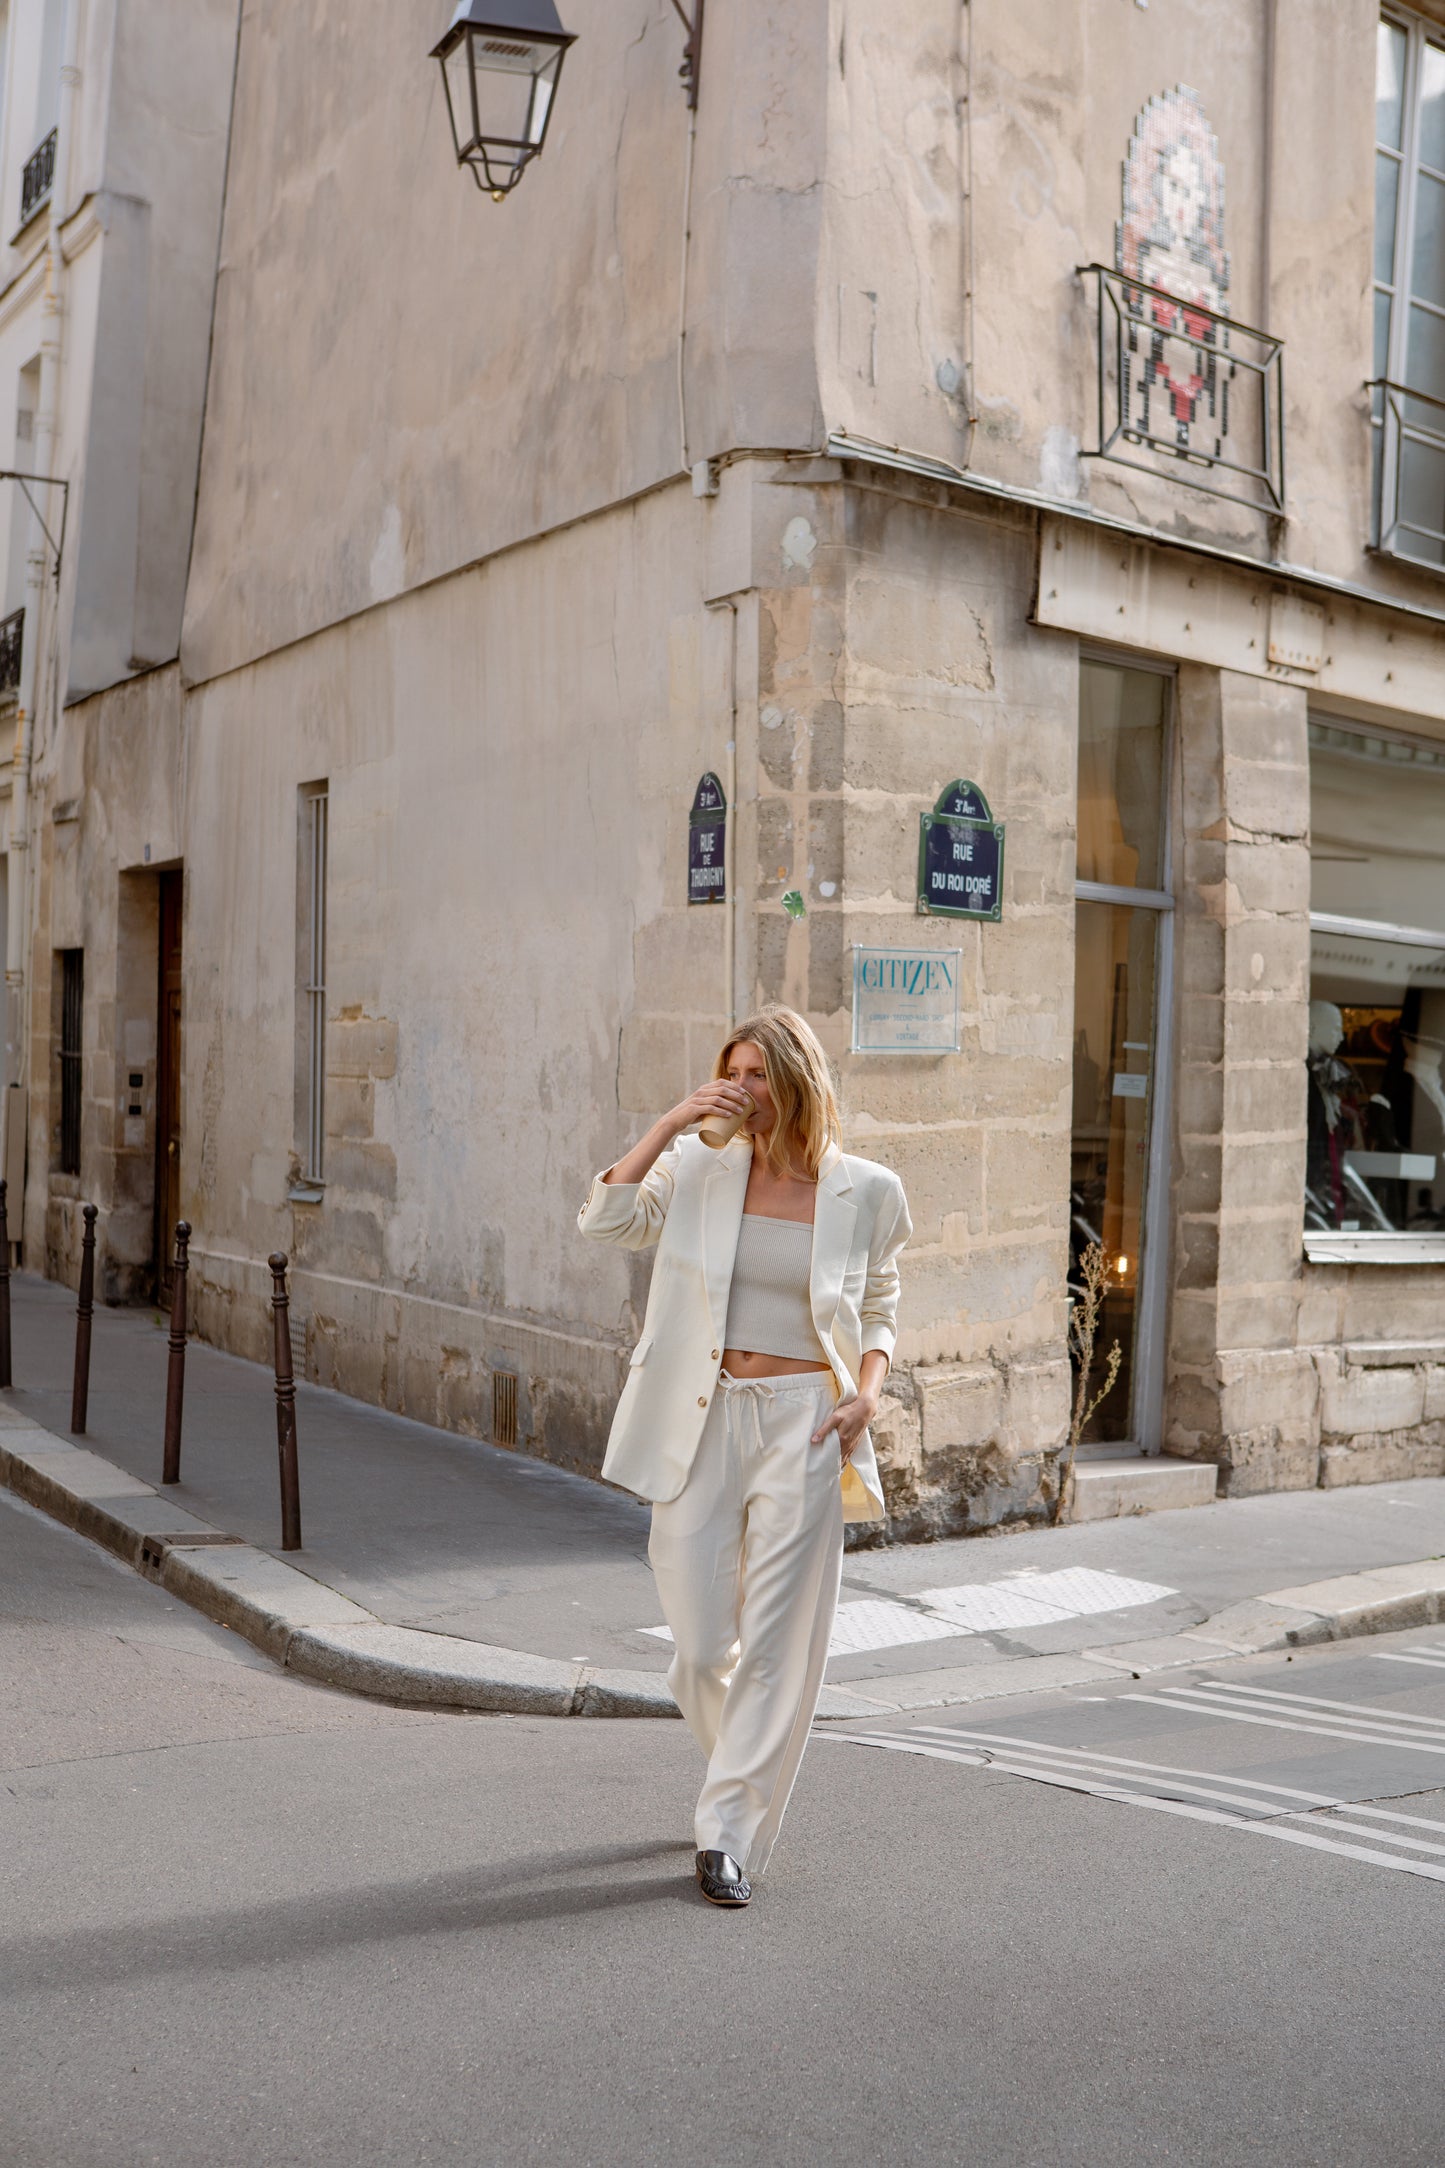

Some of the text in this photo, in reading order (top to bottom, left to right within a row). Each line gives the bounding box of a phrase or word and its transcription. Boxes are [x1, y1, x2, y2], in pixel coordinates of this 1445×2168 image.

[700, 833, 715, 852] RUE
[953, 843, 974, 861] RUE
[703, 854, 711, 865] DE
[932, 872, 992, 895] DU ROI DORÉ
[862, 959, 953, 995] CITIZEN
